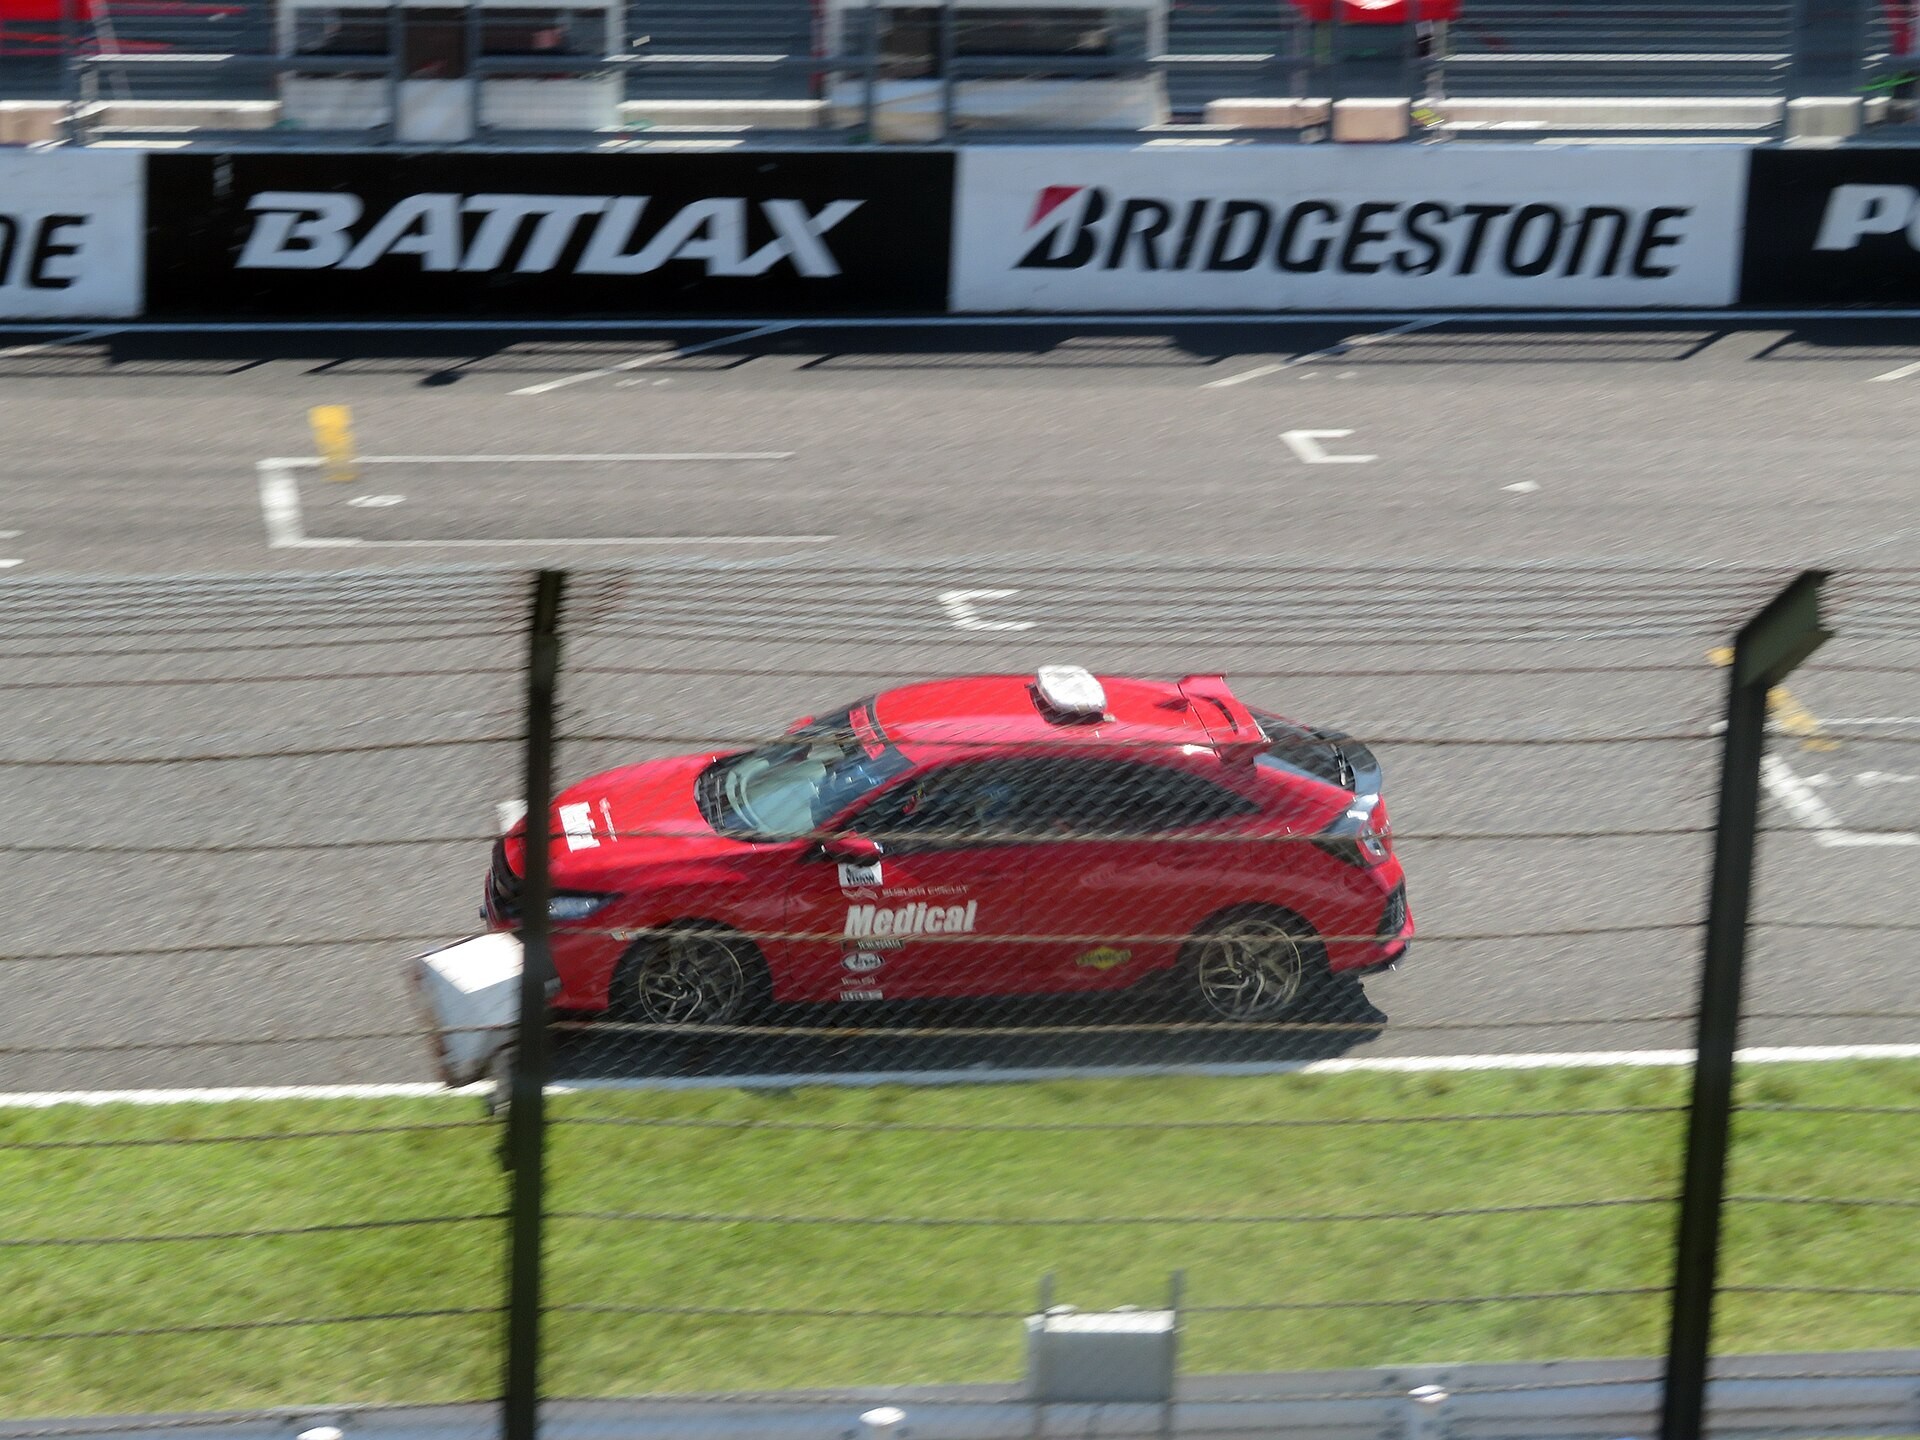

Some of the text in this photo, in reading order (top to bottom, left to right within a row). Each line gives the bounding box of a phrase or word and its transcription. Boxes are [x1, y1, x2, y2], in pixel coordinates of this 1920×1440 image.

[235, 190, 867, 278] BATTLAX
[1010, 184, 1694, 279] BRIDGESTONE
[1812, 184, 1920, 253] P
[844, 899, 978, 939] Medical
